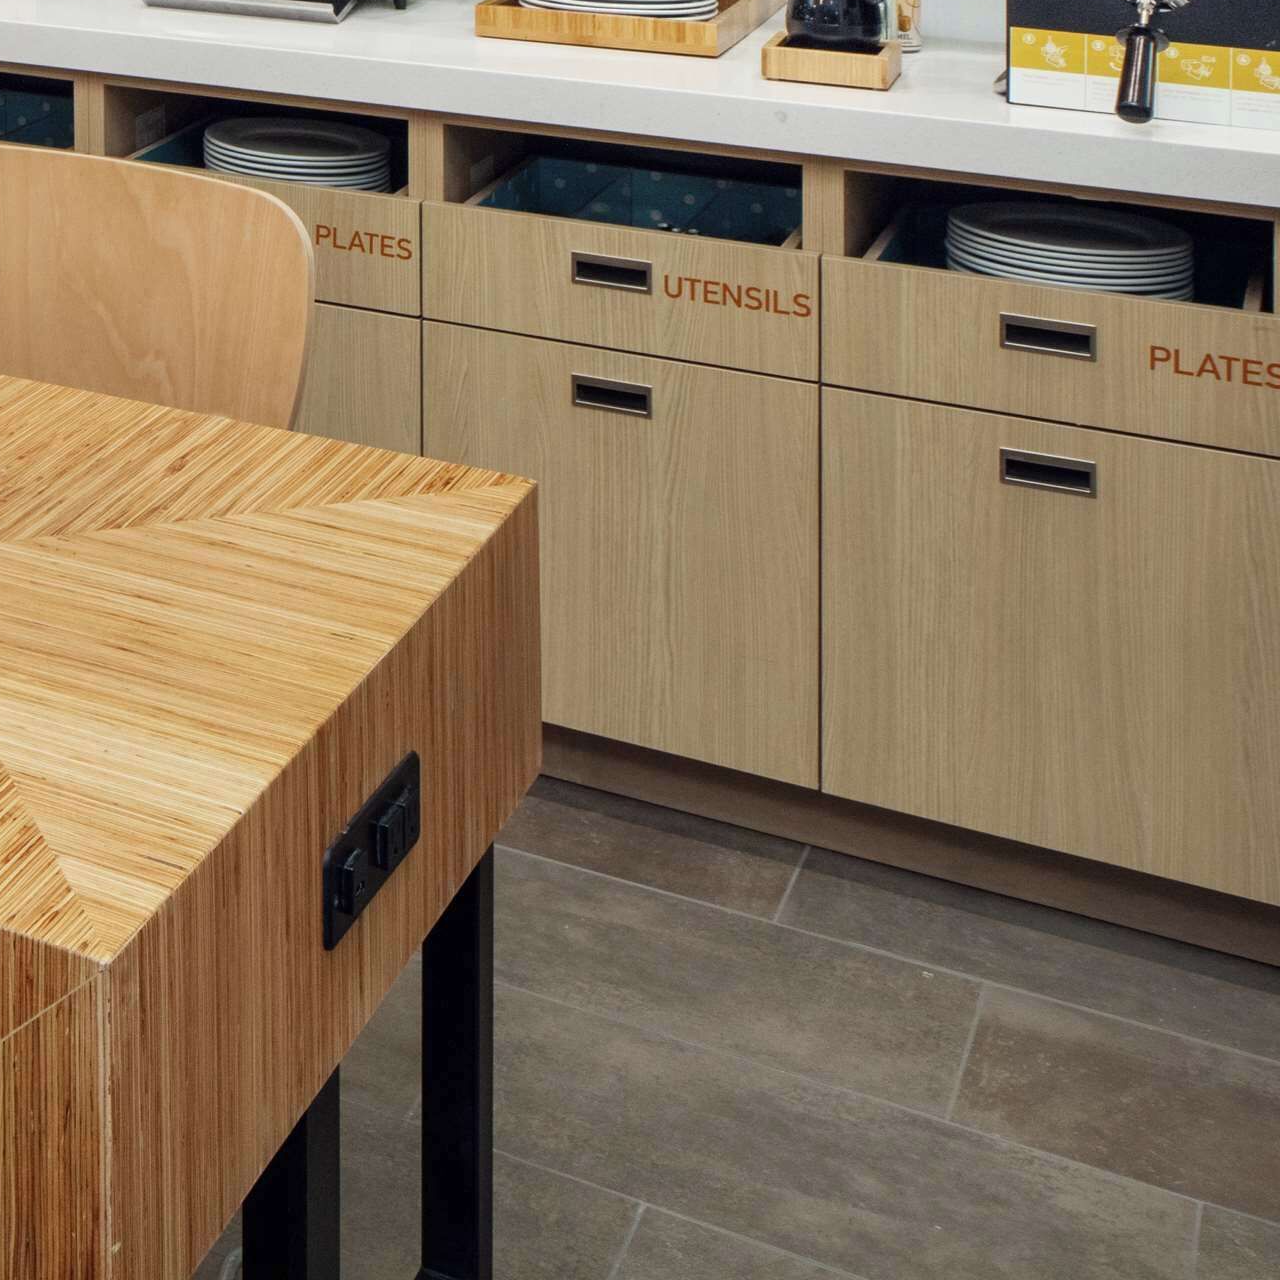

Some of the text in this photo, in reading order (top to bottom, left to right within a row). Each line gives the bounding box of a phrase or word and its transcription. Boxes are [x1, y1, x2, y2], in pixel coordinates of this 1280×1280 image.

[315, 223, 413, 261] PLATES
[663, 273, 813, 318] UTENSILS
[1149, 345, 1280, 390] PLATES
